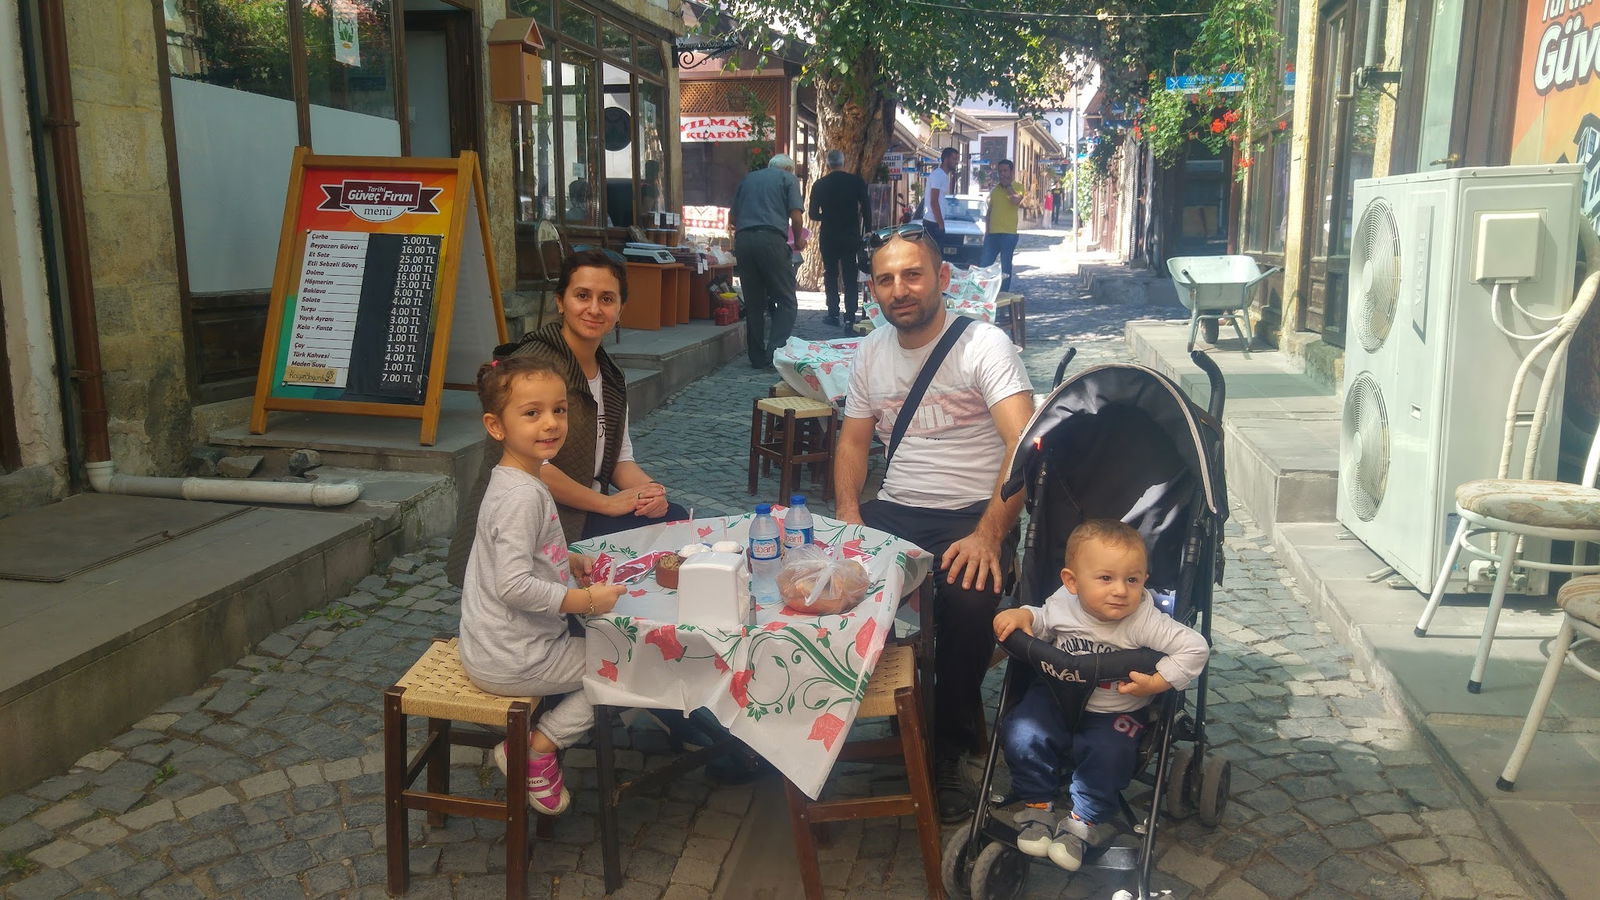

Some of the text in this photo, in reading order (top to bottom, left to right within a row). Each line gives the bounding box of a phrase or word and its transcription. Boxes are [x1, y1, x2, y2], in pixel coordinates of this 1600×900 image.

[348, 189, 412, 204] Güveç Fırını
[364, 207, 392, 216] menü
[403, 236, 430, 244] 5.00TL
[402, 246, 425, 254] 16.00
[425, 256, 434, 264] TL
[424, 265, 433, 273] TL
[396, 280, 419, 288] 15.00
[391, 308, 421, 316] 4.00 TL
[411, 317, 420, 325] TL
[389, 325, 419, 334] 3.00 TL
[388, 334, 406, 342] 1.00
[385, 354, 404, 362] 4.00
[384, 363, 414, 372] 1.00 TL
[382, 374, 412, 383] 7.00 TL
